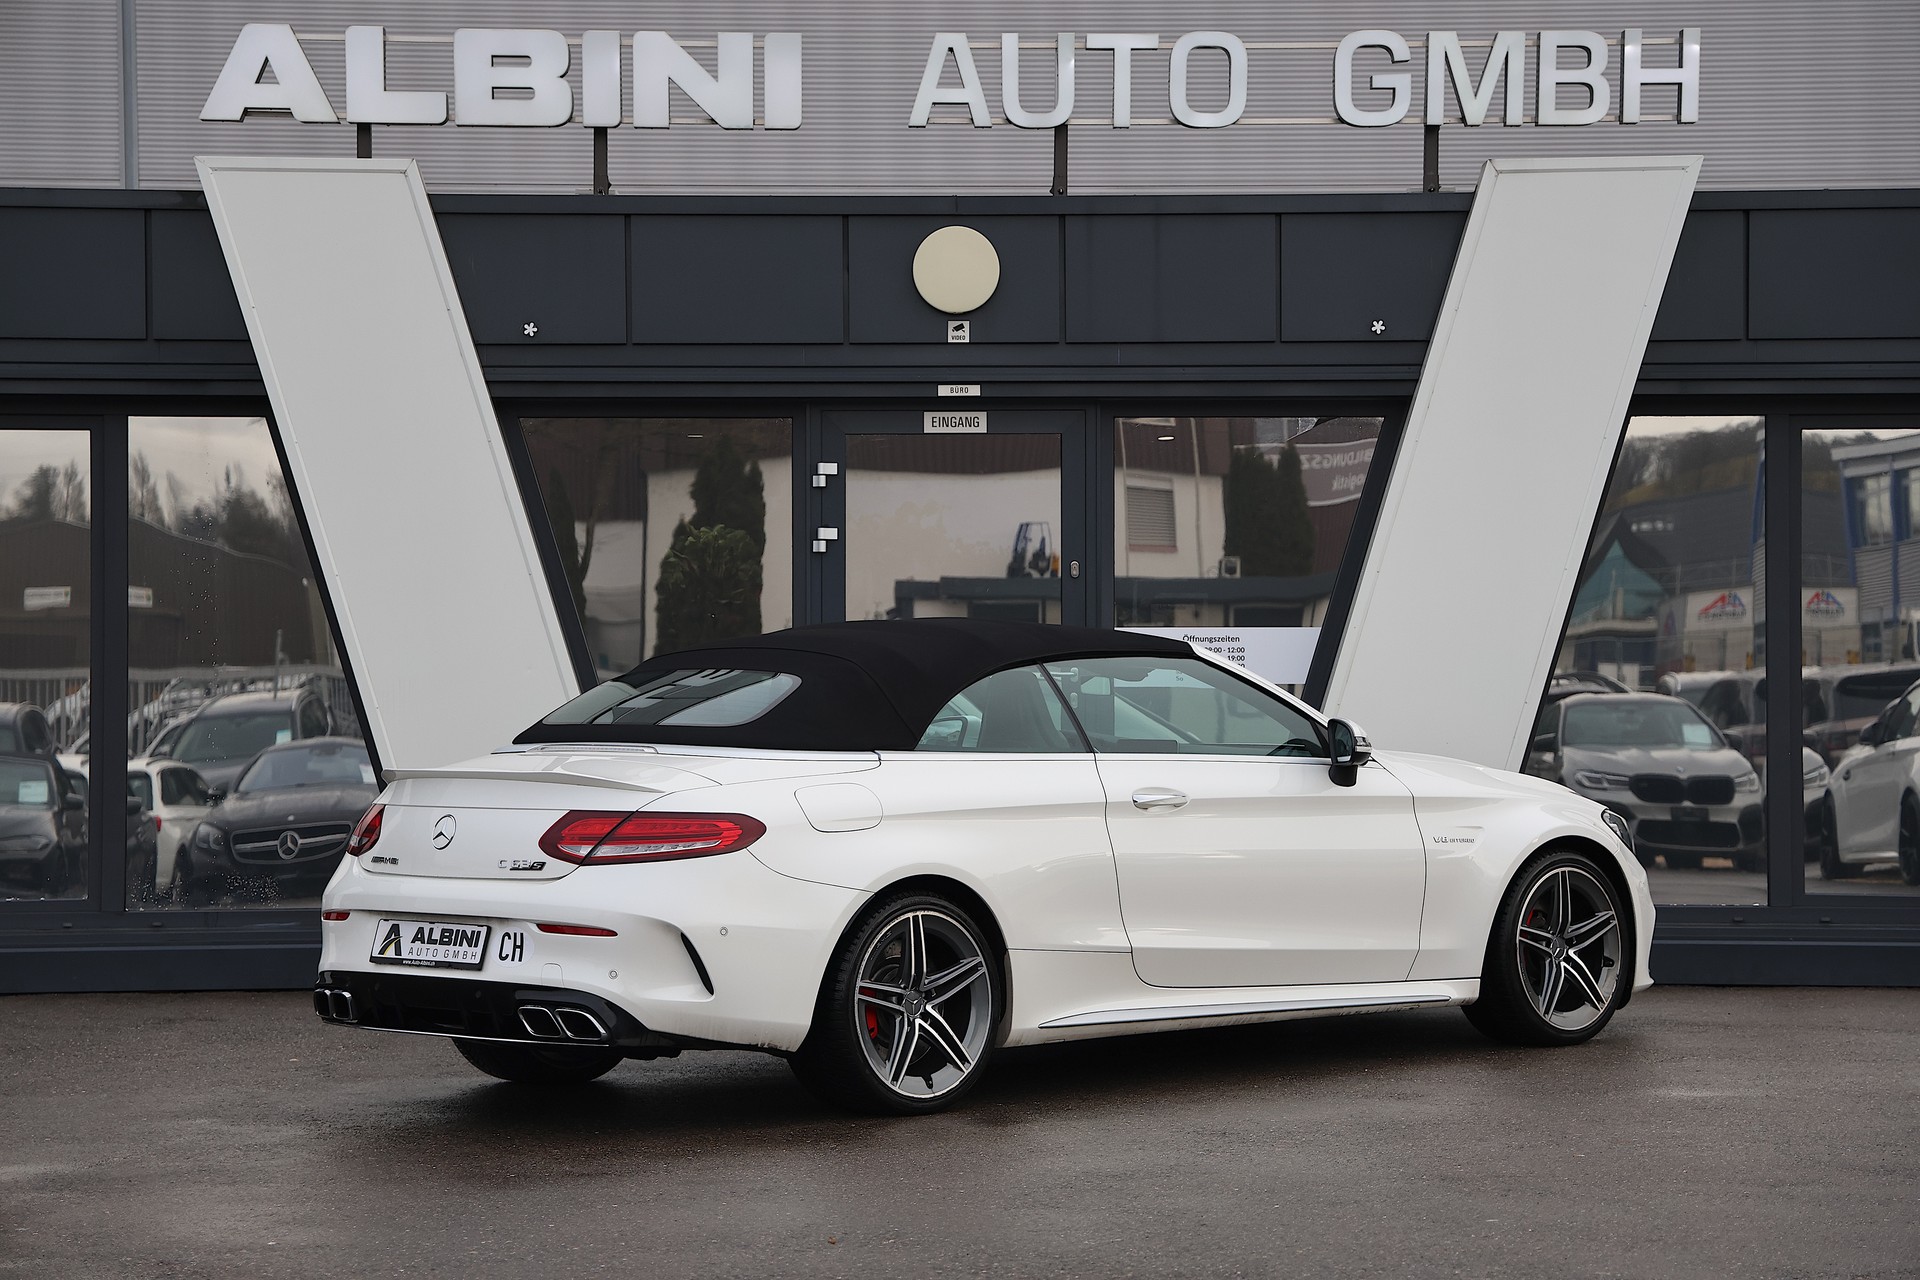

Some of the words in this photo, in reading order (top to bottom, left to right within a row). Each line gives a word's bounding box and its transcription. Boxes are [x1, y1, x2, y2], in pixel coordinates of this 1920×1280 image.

[200, 23, 803, 130] ALBINI
[908, 30, 1249, 129] AUTO
[1333, 28, 1701, 128] GMBH
[949, 386, 969, 394] BÜRO
[931, 416, 980, 428] EINGANG
[1182, 634, 1240, 643] Öffnungszeiten
[410, 926, 482, 948] ALBINI
[407, 946, 438, 958] AUTO
[443, 949, 478, 961] GMBH
[498, 931, 525, 963] CH
